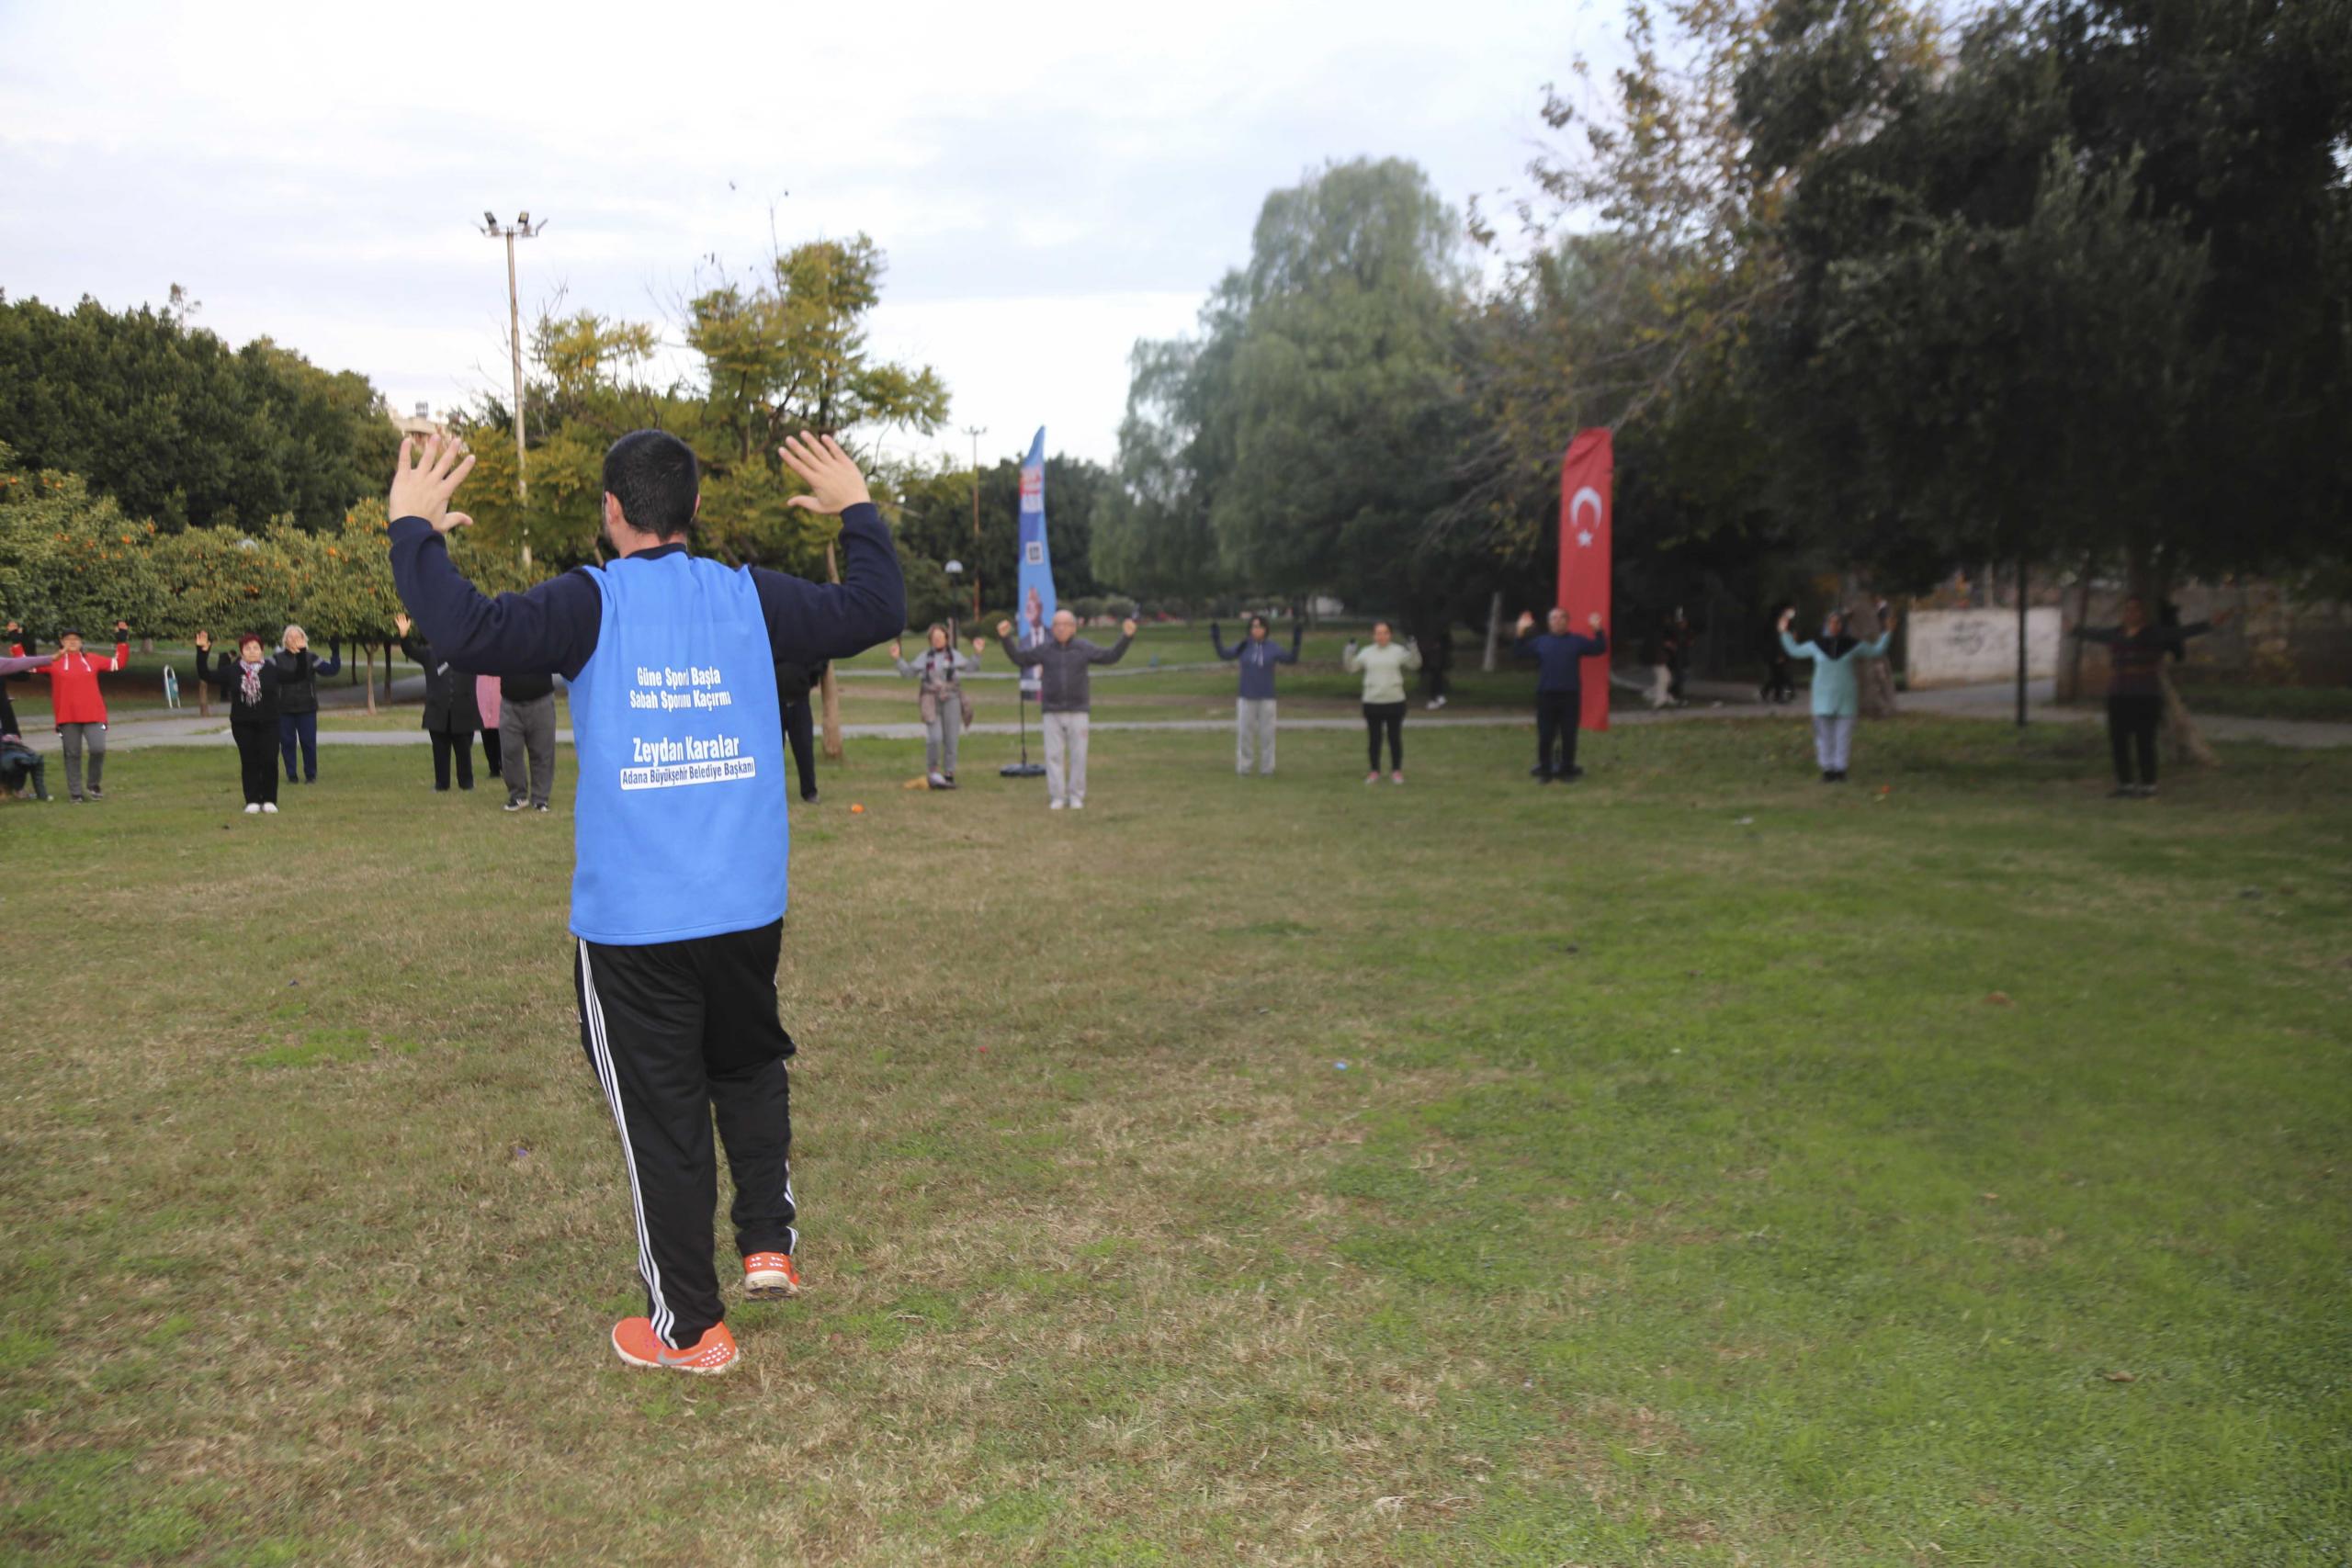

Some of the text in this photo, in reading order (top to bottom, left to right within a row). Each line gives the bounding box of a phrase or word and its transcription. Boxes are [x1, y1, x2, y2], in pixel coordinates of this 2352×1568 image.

[637, 667, 662, 686] Güne
[691, 666, 721, 690] Başla
[629, 690, 658, 708] Sabah
[633, 734, 740, 768] Zeydan Karalar
[622, 761, 754, 785] Adana Büyükşehir Belediye Başkanı
